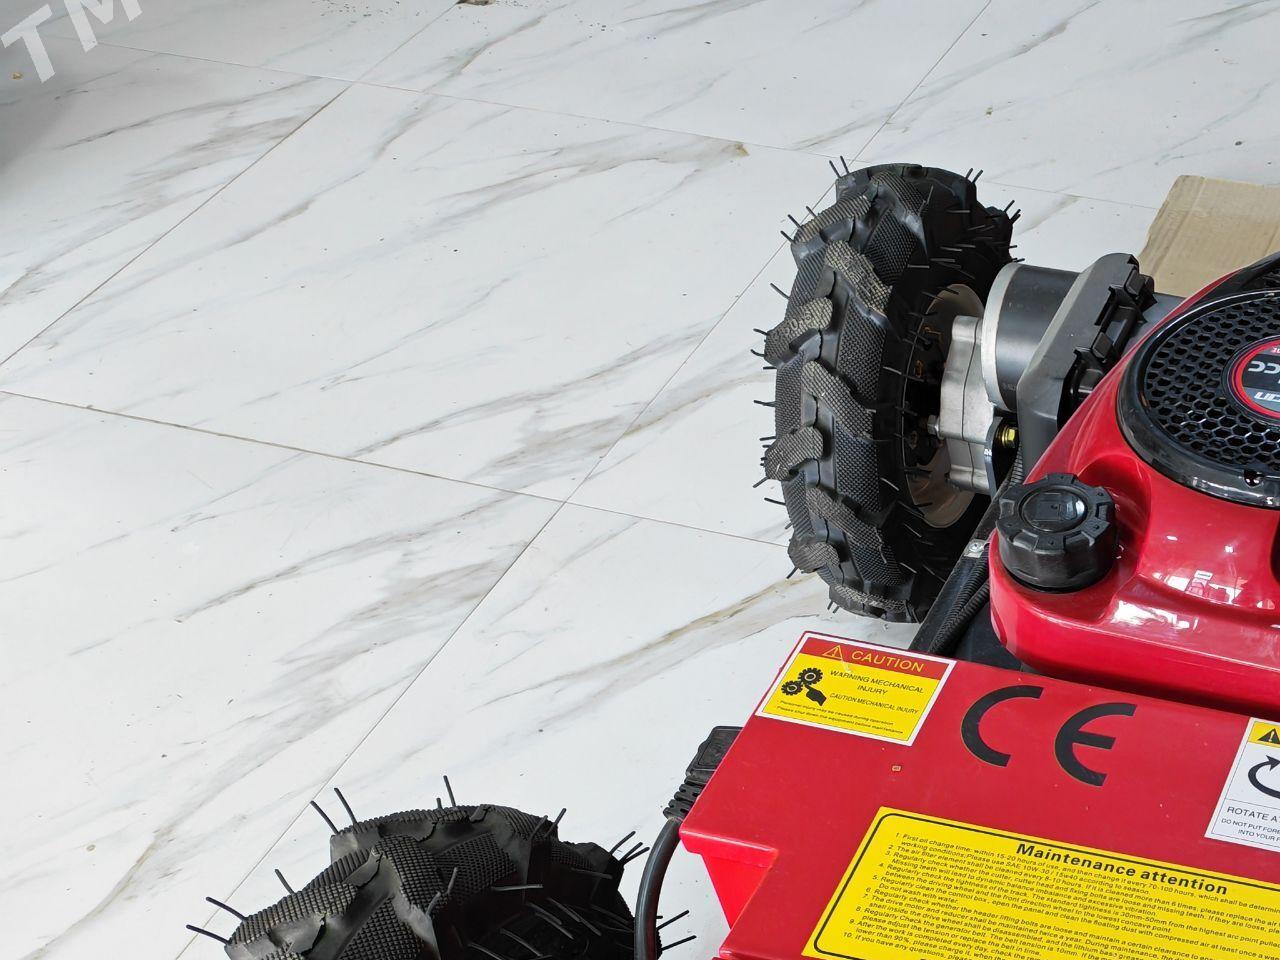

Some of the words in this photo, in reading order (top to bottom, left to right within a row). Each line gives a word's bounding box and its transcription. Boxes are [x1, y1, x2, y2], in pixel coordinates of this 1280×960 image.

[848, 649, 926, 673] CAUTION
[828, 669, 871, 683] WARNING
[869, 677, 925, 693] MECHANICAL
[856, 684, 888, 695] INJURY
[828, 692, 858, 703] CAUTION
[855, 697, 897, 710] MECHANICAL
[895, 705, 919, 715] INJURY
[961, 684, 1137, 787] CE
[1225, 805, 1269, 821] ROTATE
[1231, 819, 1247, 828] NOT
[1247, 823, 1262, 831] PUT
[1237, 828, 1255, 837] INTO
[1254, 832, 1275, 841] YOUR
[1014, 842, 1138, 877] Maintenance
[1139, 867, 1230, 896] attention
